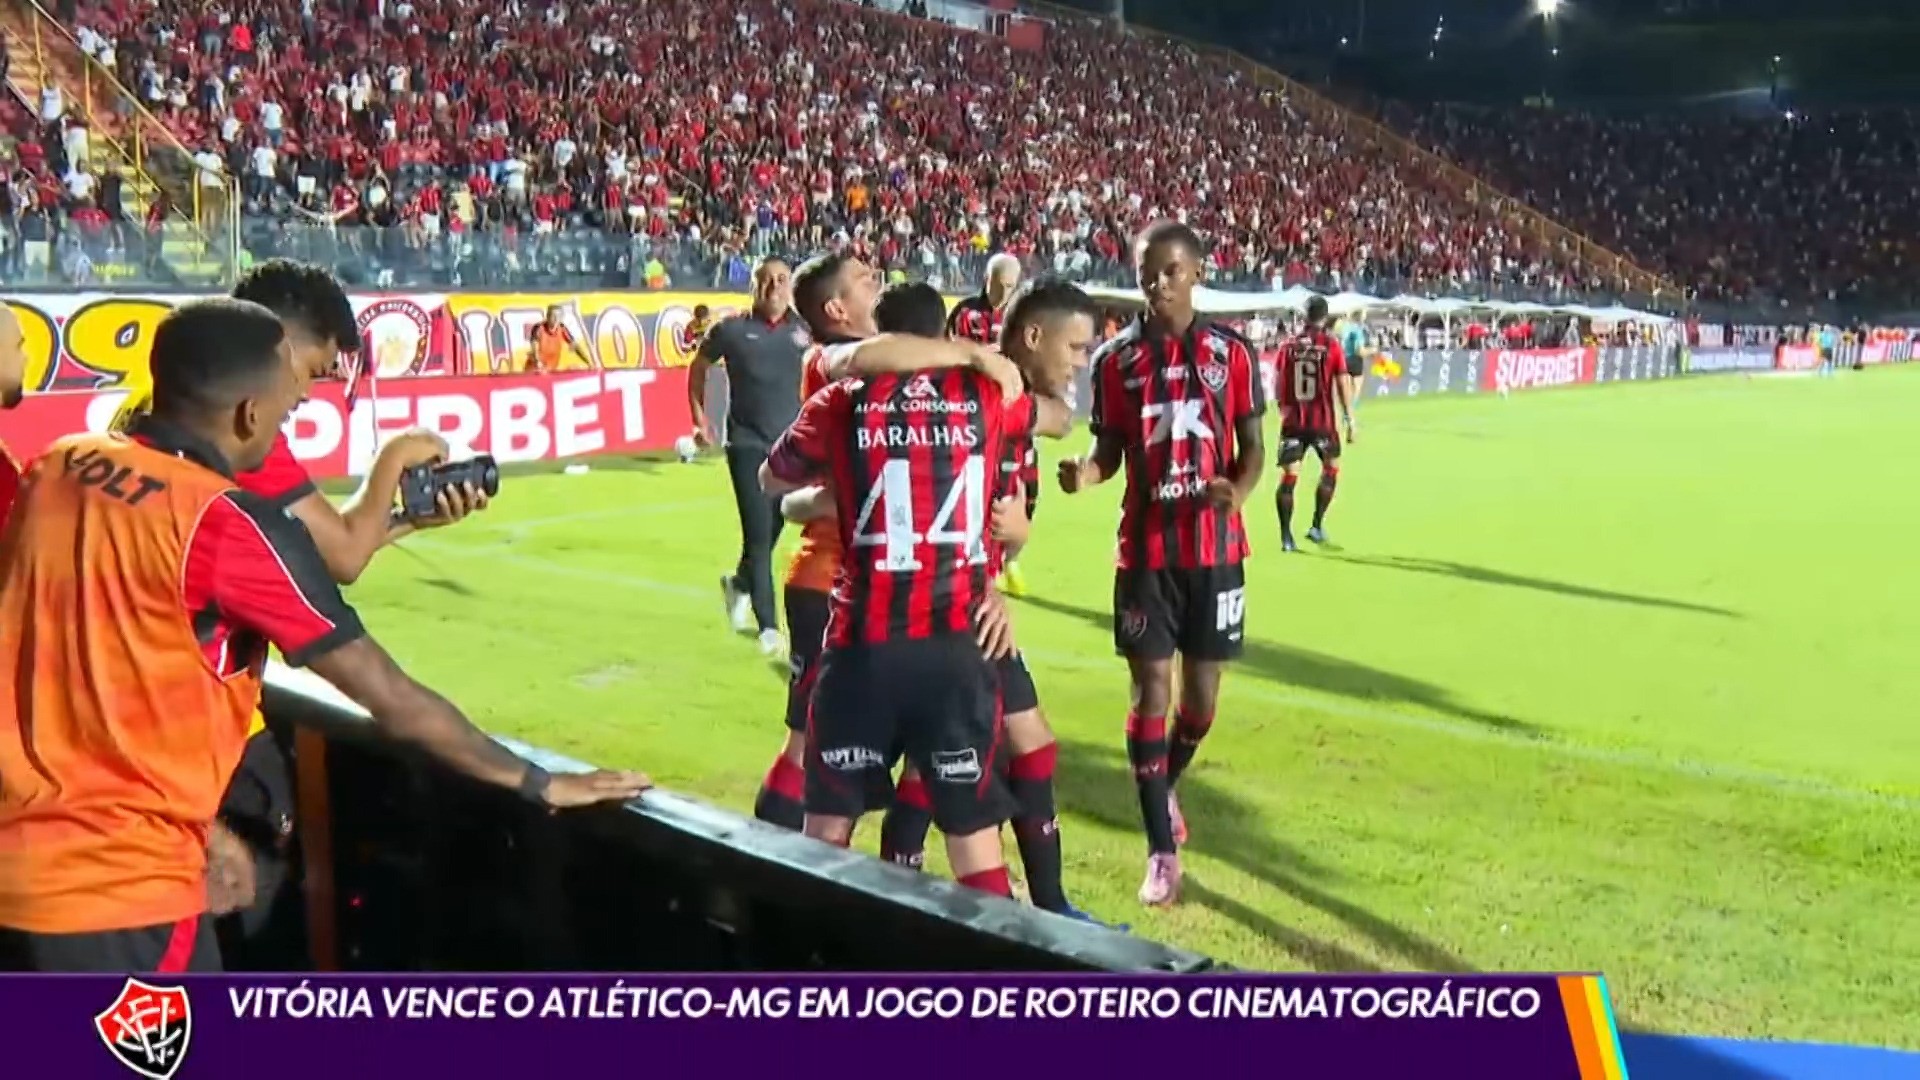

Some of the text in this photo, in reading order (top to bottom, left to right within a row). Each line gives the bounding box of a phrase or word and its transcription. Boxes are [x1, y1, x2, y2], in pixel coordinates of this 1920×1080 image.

[1294, 360, 1317, 401] 6
[1495, 348, 1586, 389] SUPERBET
[857, 425, 978, 450] BARALHAS
[1141, 398, 1215, 446] 7K
[63, 445, 166, 505] VOLT
[853, 455, 987, 571] 44
